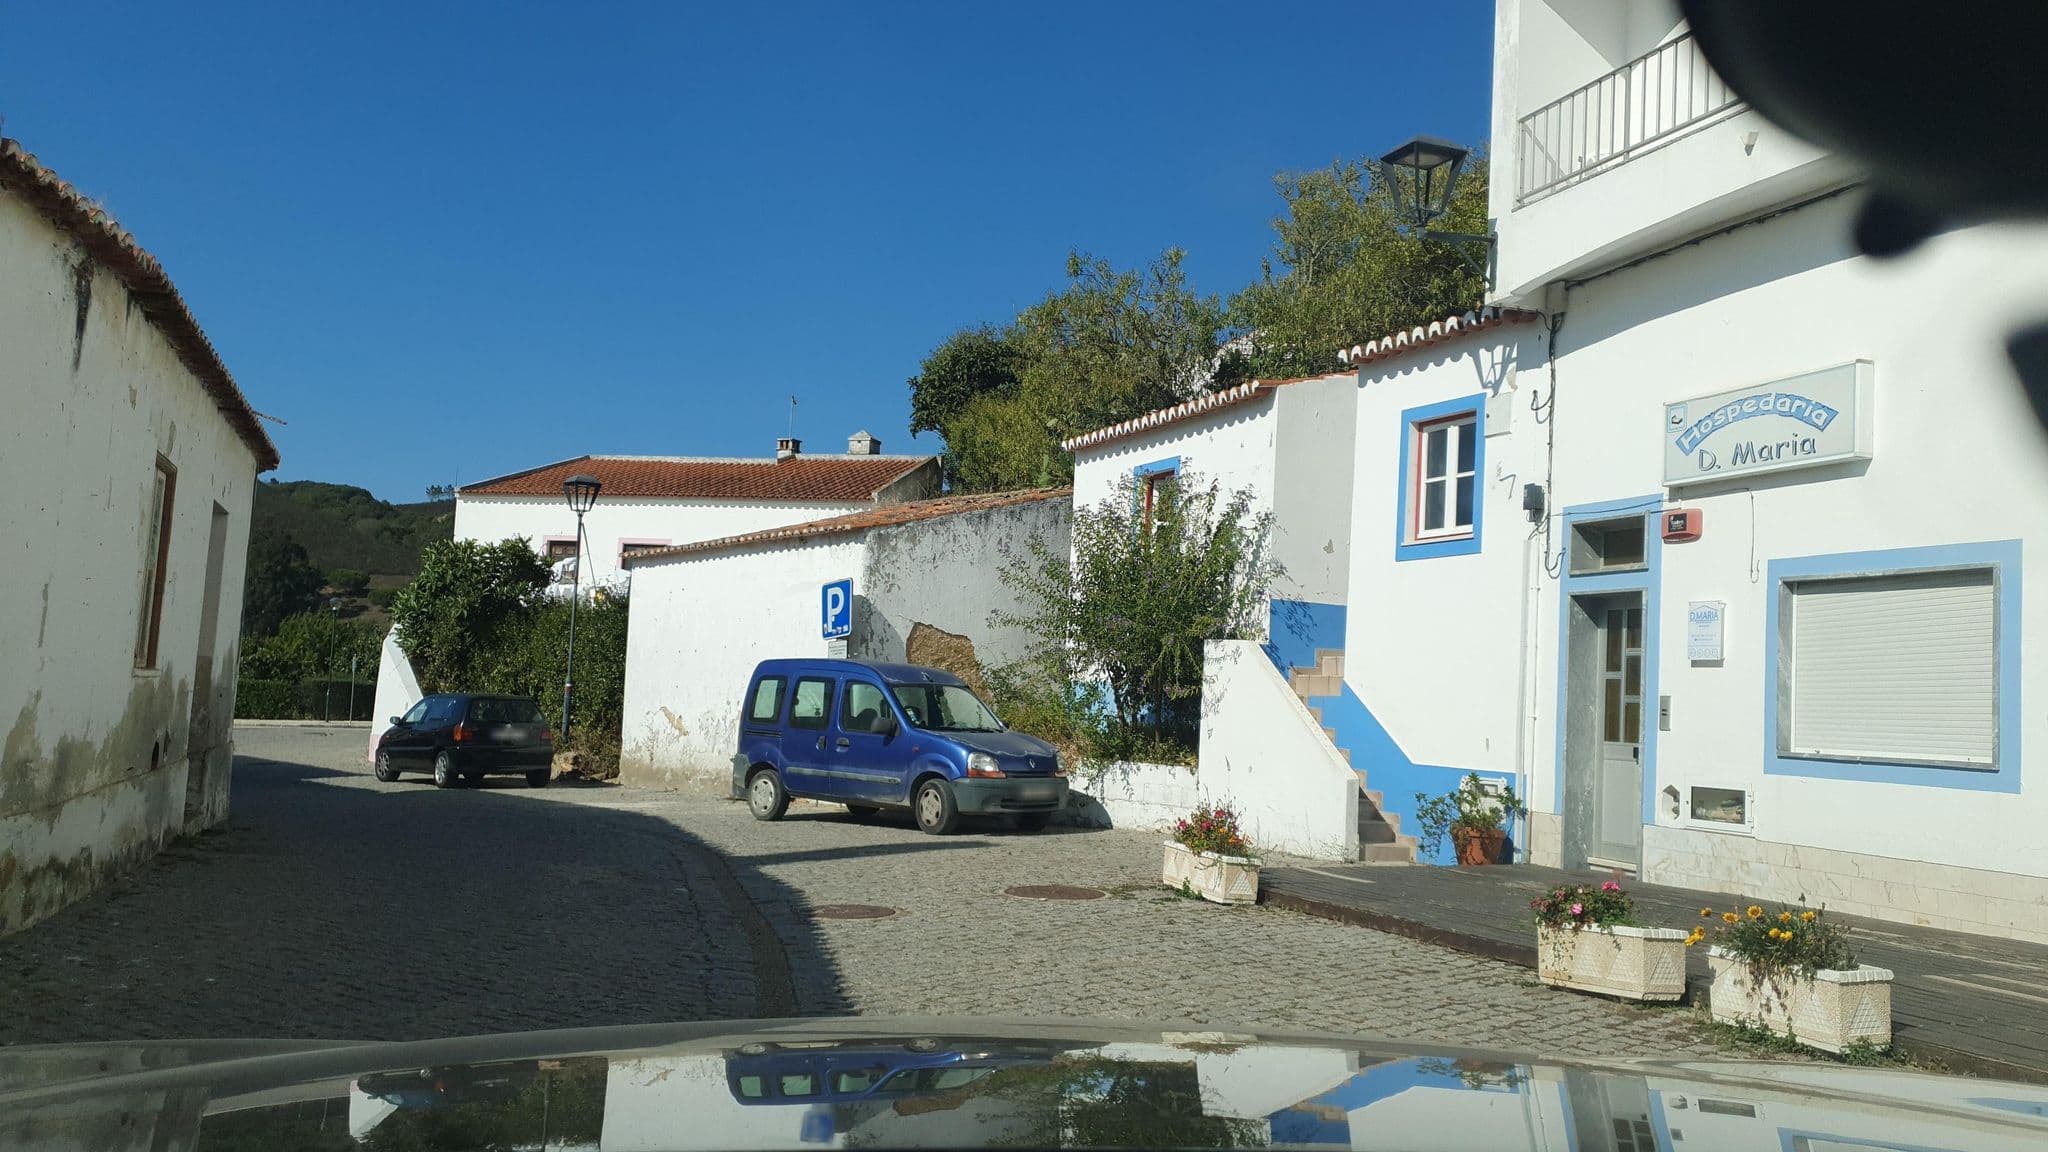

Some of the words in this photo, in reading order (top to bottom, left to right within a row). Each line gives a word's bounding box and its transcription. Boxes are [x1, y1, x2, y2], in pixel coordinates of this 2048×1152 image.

[1680, 392, 1830, 450] Hospedaria
[1699, 449, 1721, 471] D.
[1731, 433, 1816, 466] Maria
[827, 587, 844, 632] P
